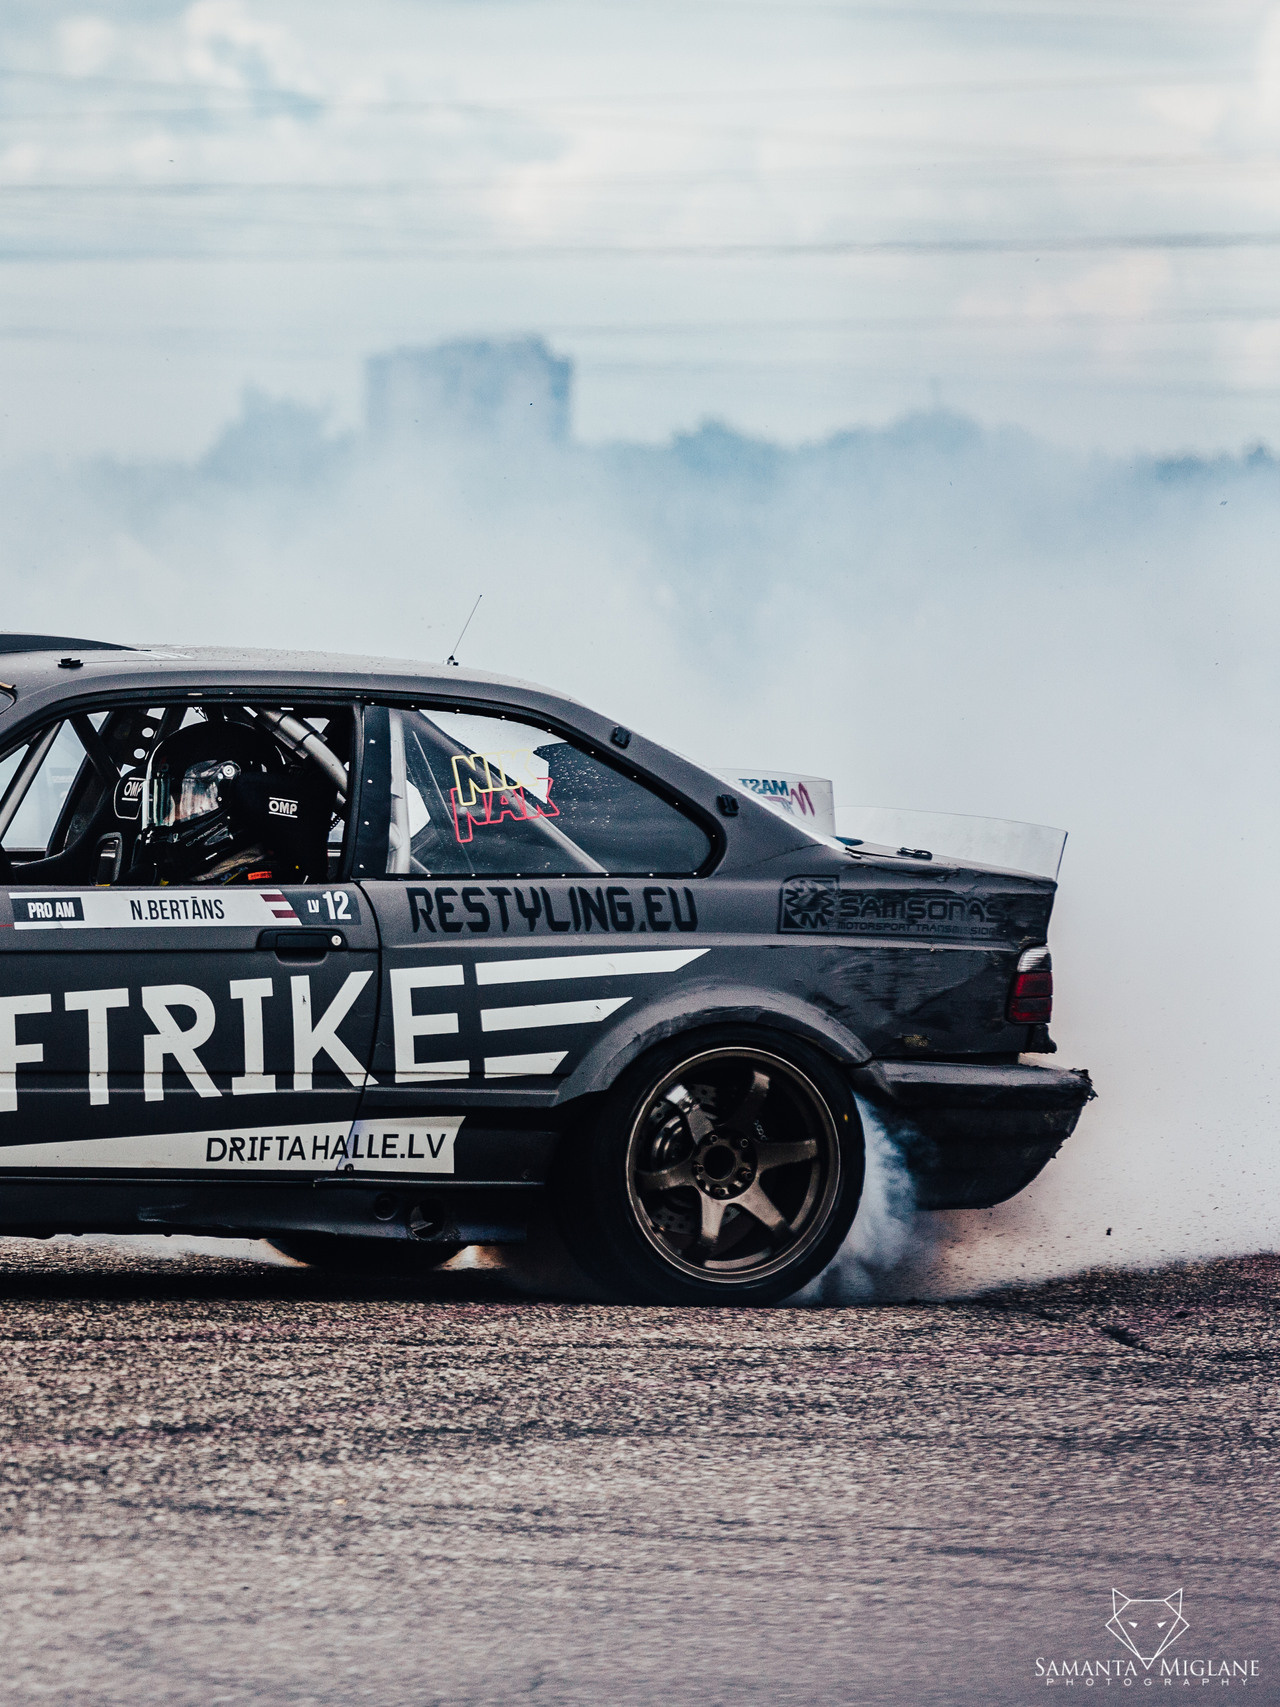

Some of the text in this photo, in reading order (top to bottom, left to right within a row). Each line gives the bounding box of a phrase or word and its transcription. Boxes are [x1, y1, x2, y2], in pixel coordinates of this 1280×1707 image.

[452, 749, 538, 806] NIK
[269, 800, 298, 815] OMP
[27, 902, 75, 918] PRO AM
[131, 896, 225, 920] N.BERTĀNS
[307, 890, 352, 920] LV 12
[406, 886, 699, 933] RESTYLING.EU
